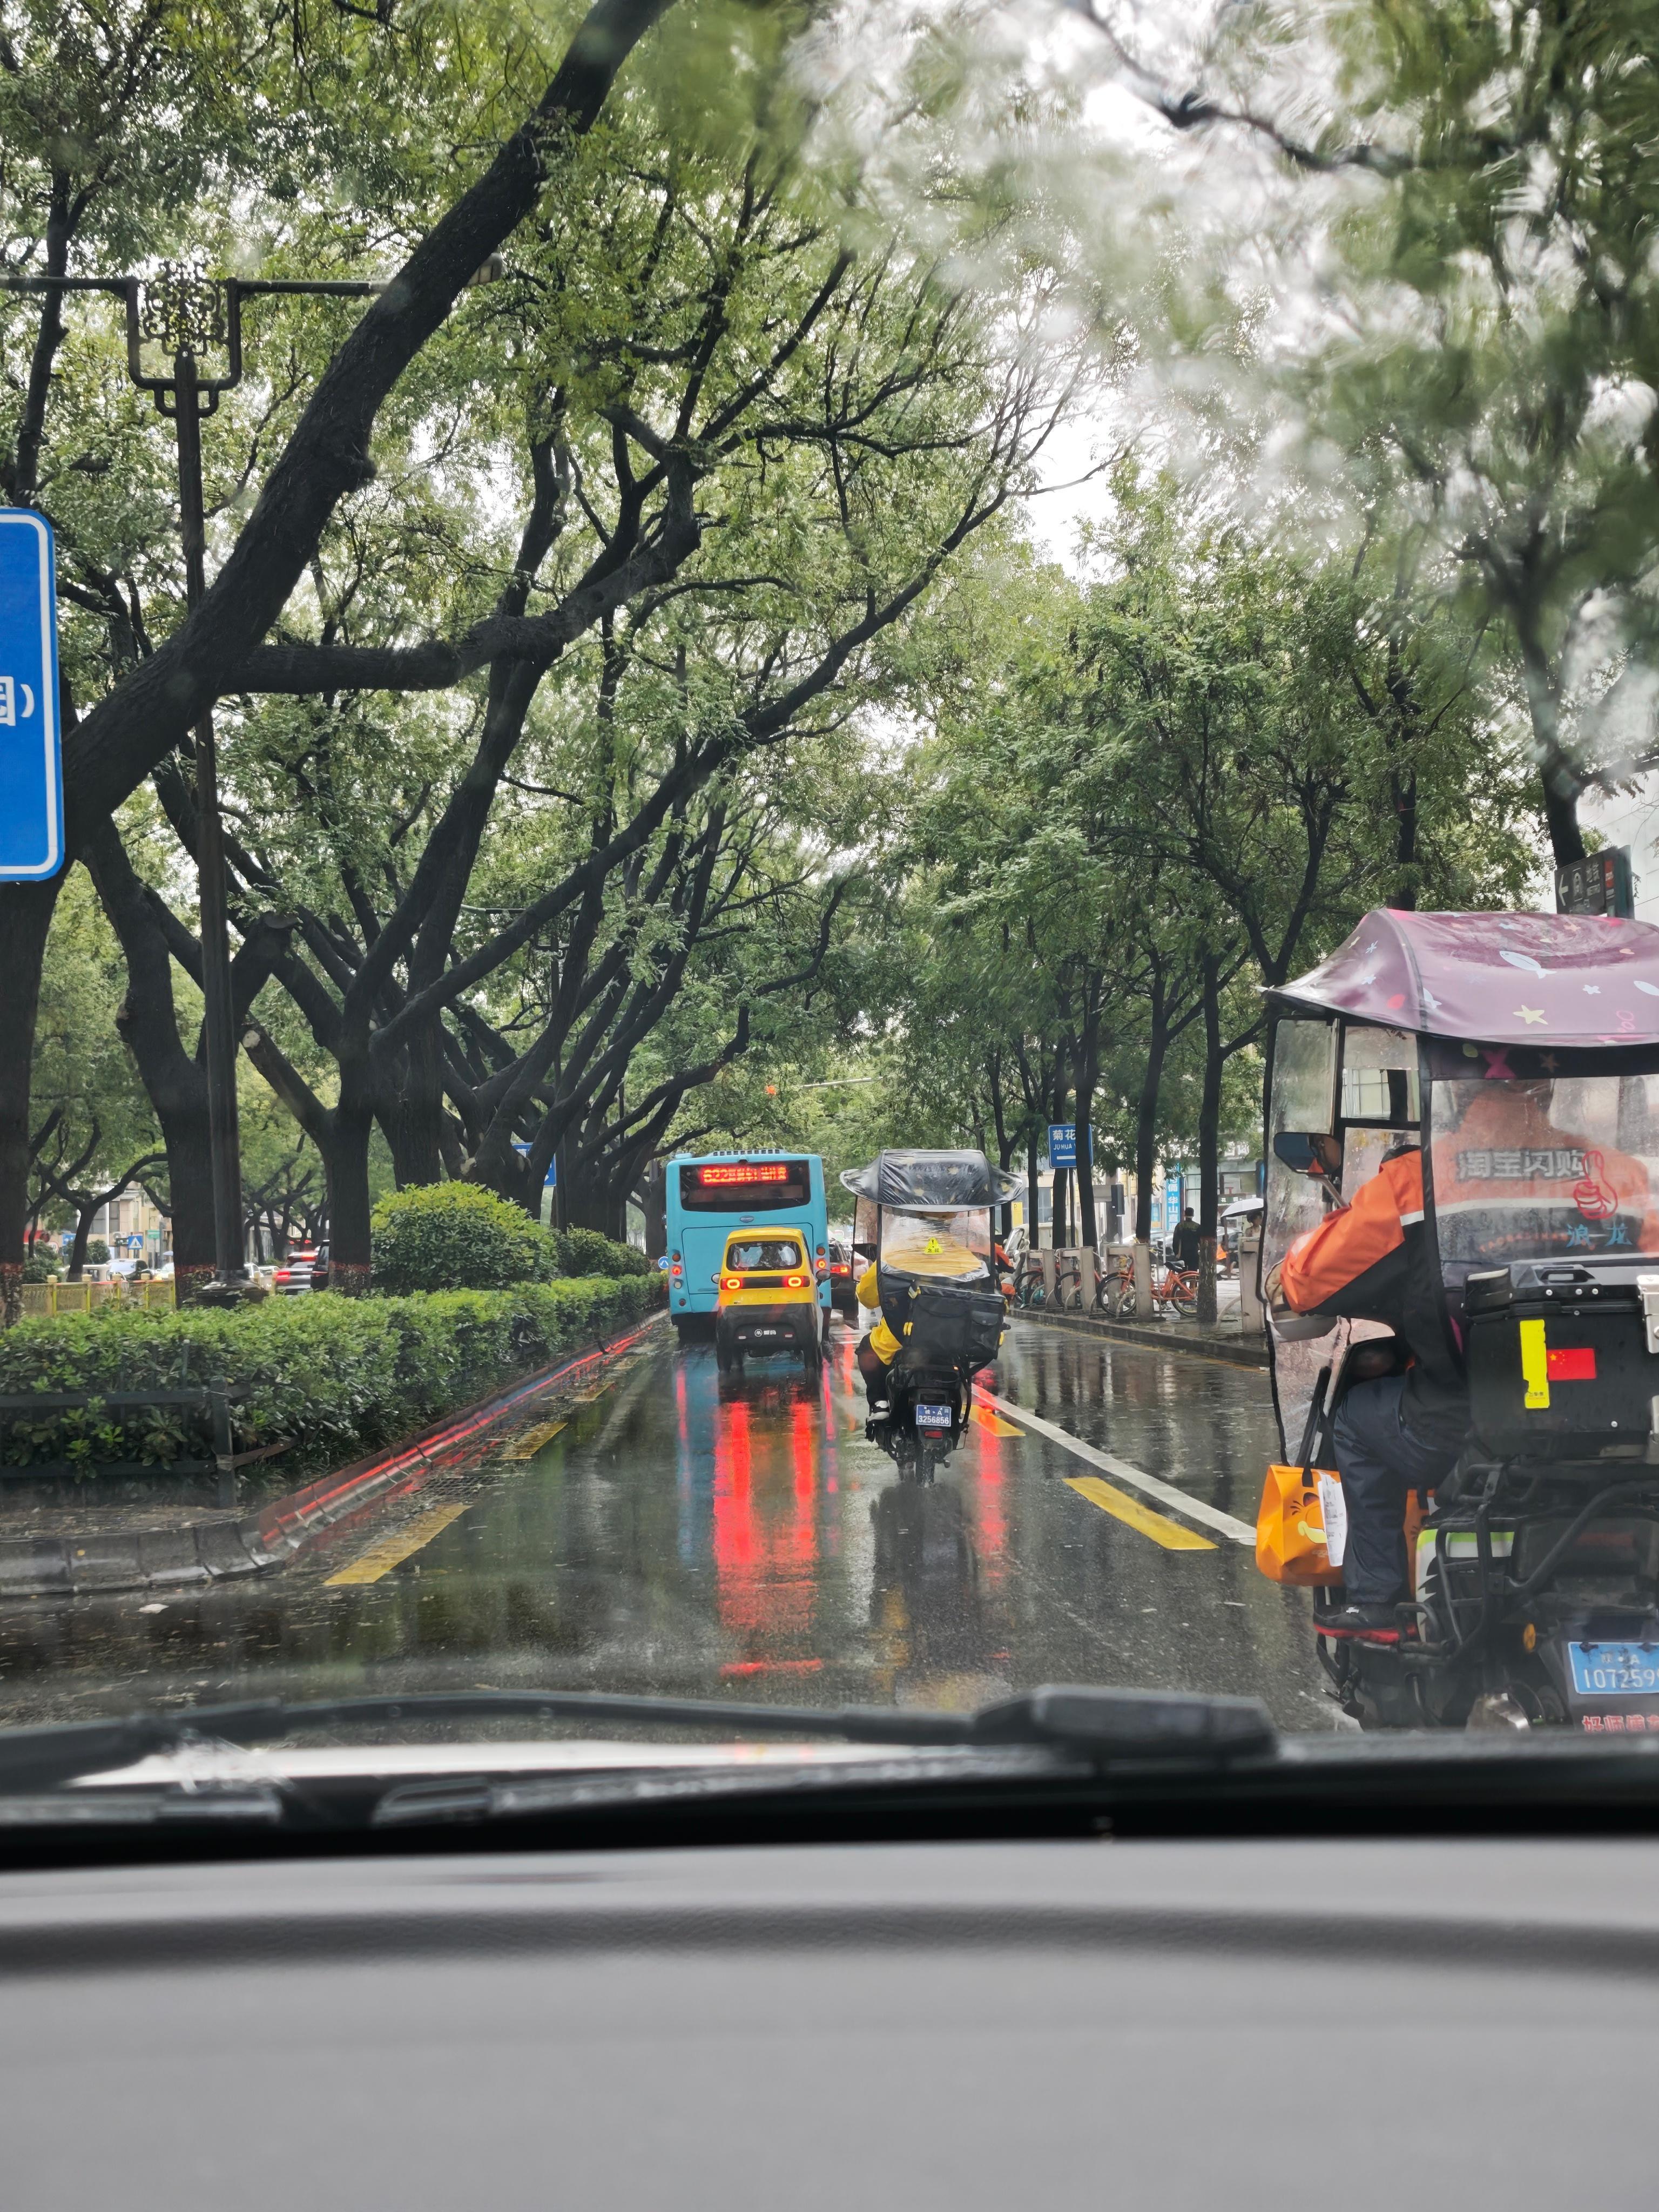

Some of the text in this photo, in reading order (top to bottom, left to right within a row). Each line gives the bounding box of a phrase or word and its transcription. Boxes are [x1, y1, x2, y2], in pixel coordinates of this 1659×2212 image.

[1459, 1149, 1588, 1178] 淘宝闪购
[918, 1415, 949, 1425] 3256856
